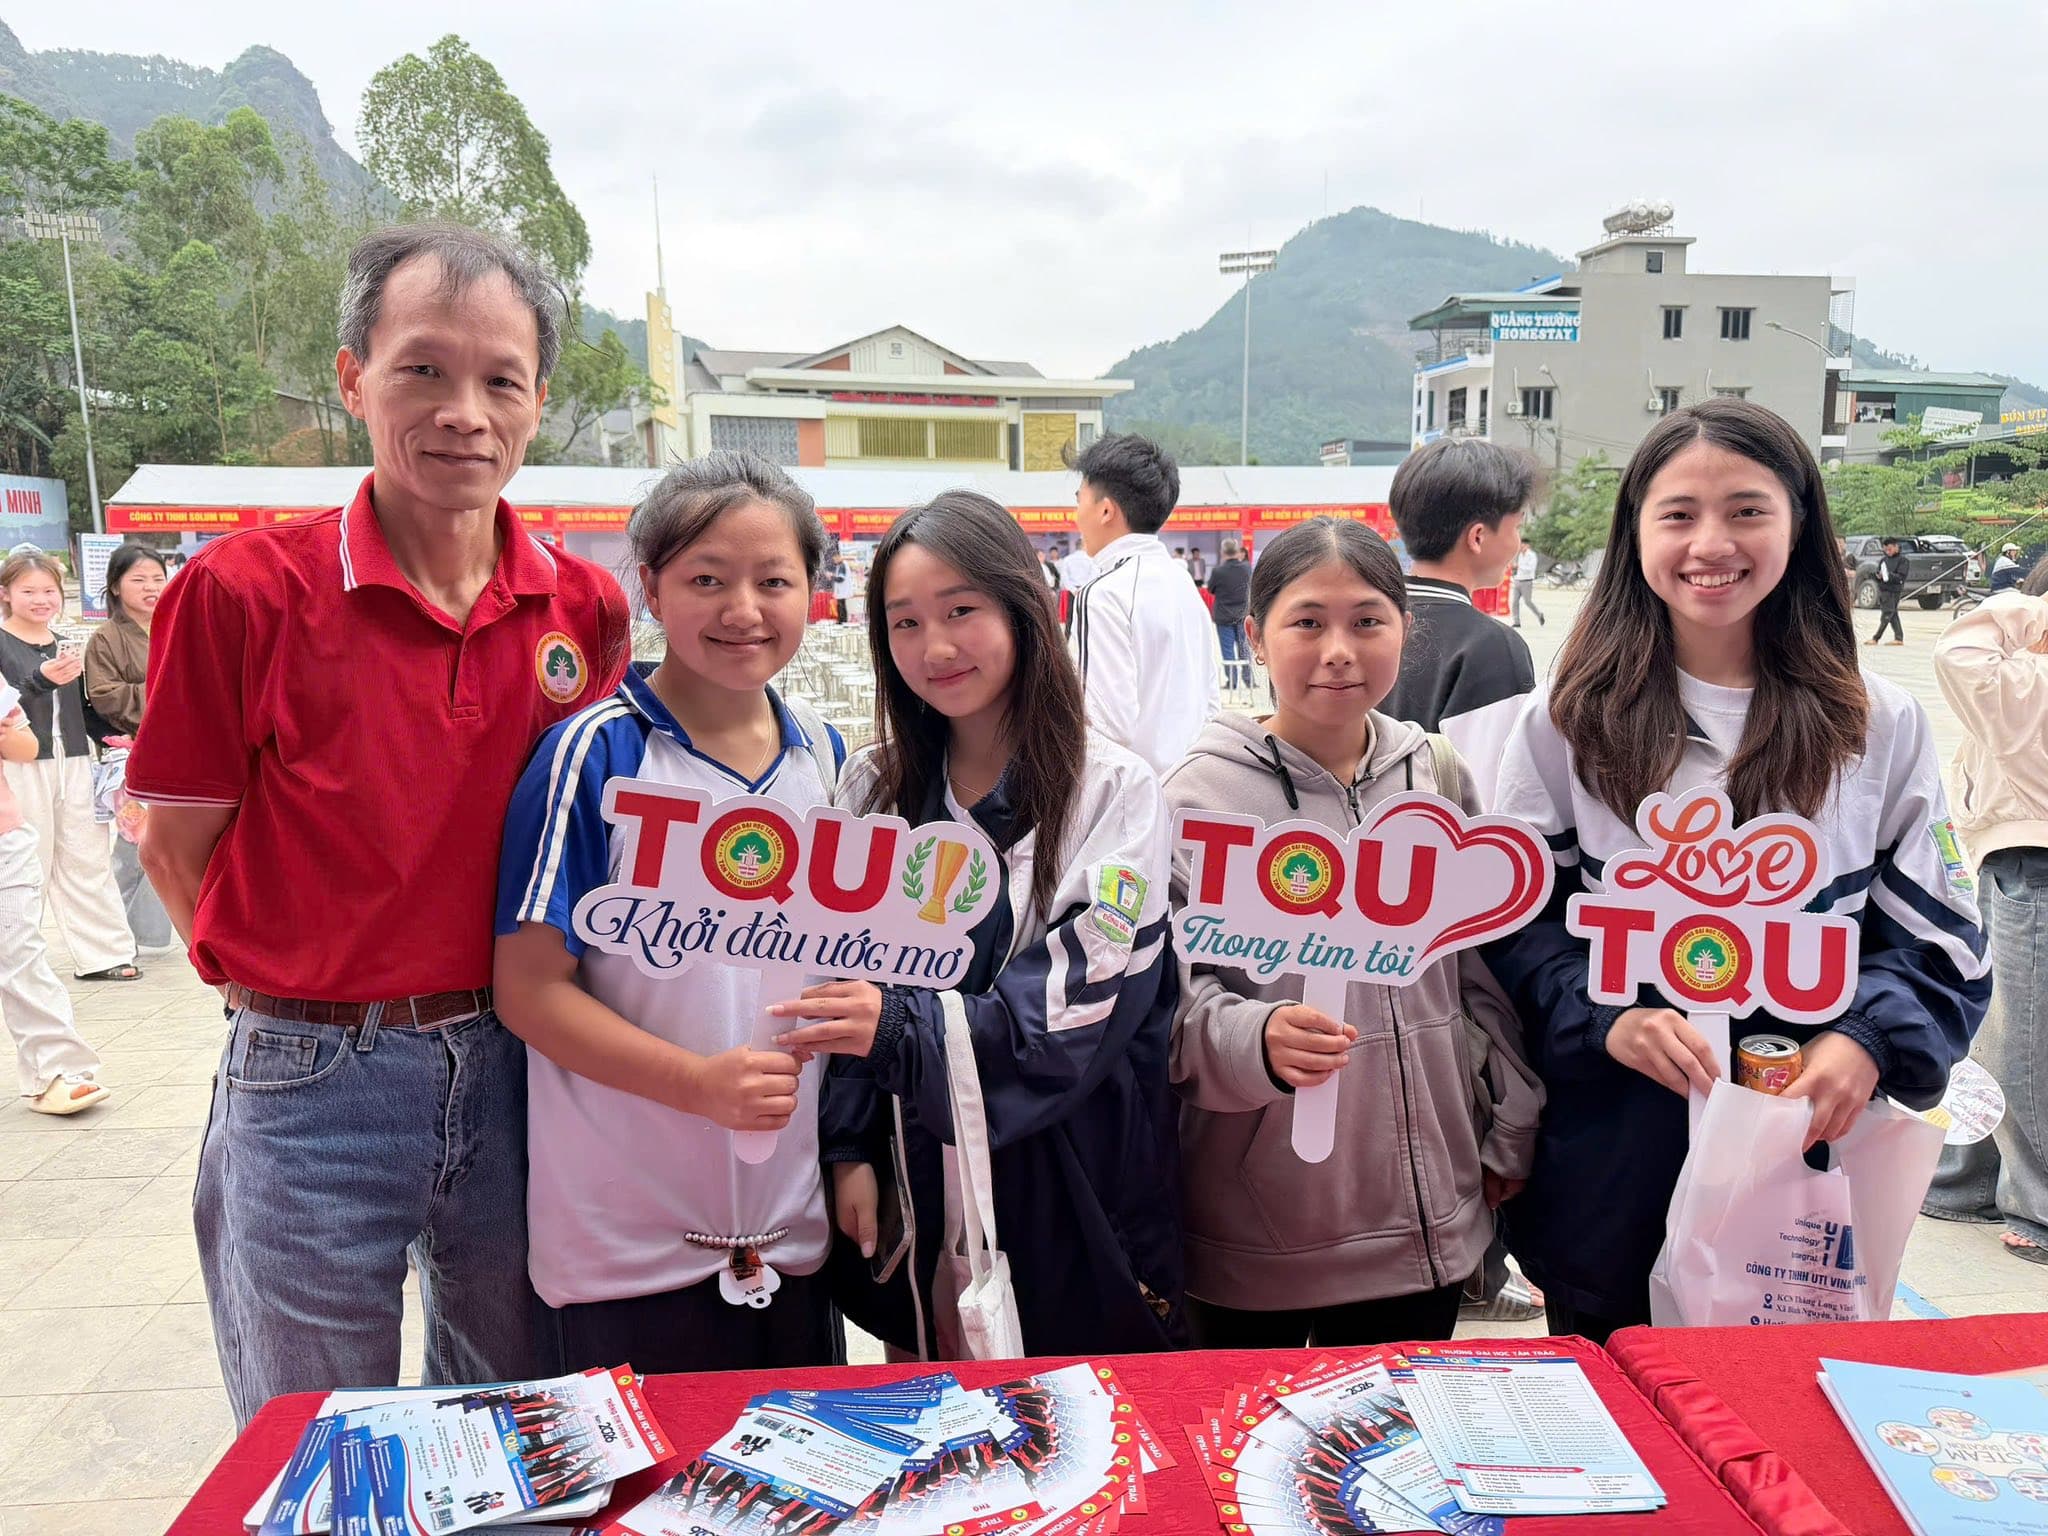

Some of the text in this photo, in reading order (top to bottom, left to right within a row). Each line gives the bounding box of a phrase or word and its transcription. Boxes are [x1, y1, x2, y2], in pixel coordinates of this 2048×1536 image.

[1491, 310, 1533, 328] QUẢNG
[1500, 327, 1574, 340] HOMESTAY
[6, 489, 42, 515] MINH
[614, 790, 898, 913] TQU
[1182, 819, 1437, 926] TQU
[586, 896, 963, 980] Khởi đầu ước mơ
[1183, 915, 1416, 977] Trong tim tôi
[1579, 904, 1848, 1012] TQU
[1795, 1218, 1821, 1230] Unique
[1779, 1232, 1820, 1246] Technology
[1746, 1262, 1771, 1276] CÔNG
[1774, 1268, 1786, 1279] TY
[1788, 1270, 1809, 1282] TNHH
[1811, 1273, 1828, 1286] UTI
[1818, 1299, 1837, 1311] Long
[1345, 1381, 1375, 1395] 2026
[504, 1429, 520, 1453] TQU
[599, 1421, 618, 1443] 2026
[1944, 1448, 2023, 1464] STEAM
[779, 1483, 810, 1500] TQU
